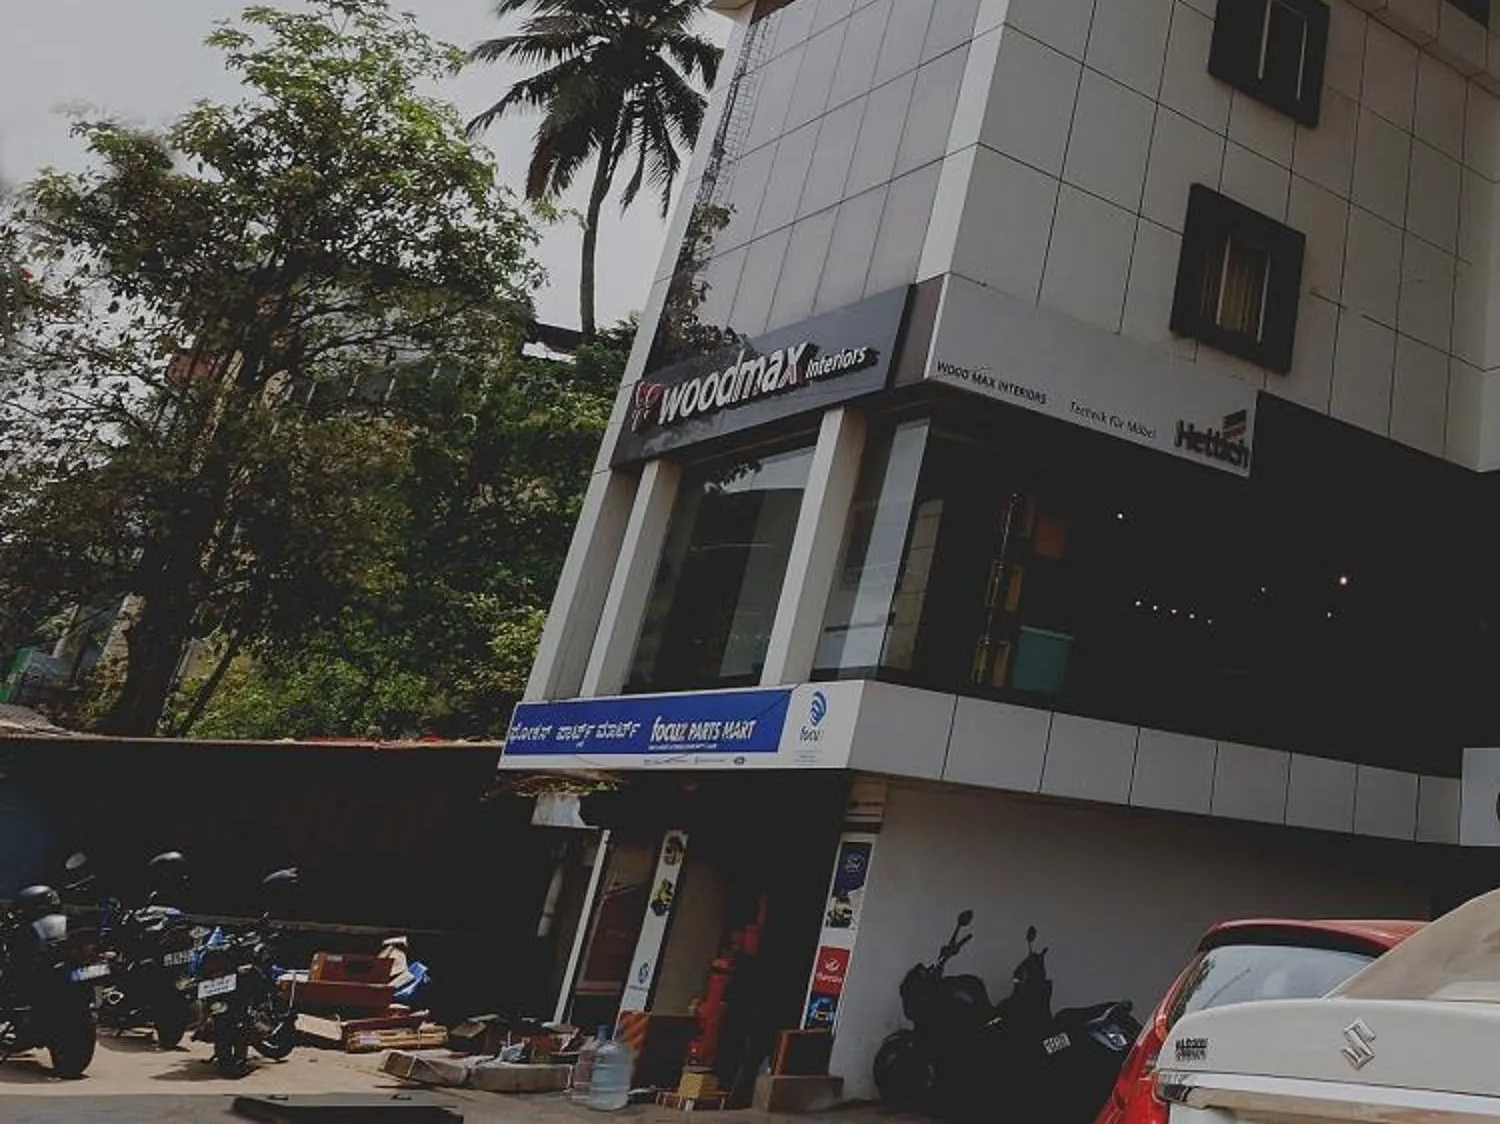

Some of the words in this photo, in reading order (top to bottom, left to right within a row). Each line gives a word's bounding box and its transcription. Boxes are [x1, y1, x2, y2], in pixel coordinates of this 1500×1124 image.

[658, 342, 809, 425] woodmax
[937, 360, 969, 380] WOOD
[972, 371, 996, 390] MAX
[997, 379, 1048, 405] INTERIORS
[687, 721, 721, 741] PARTS
[721, 719, 757, 739] MART
